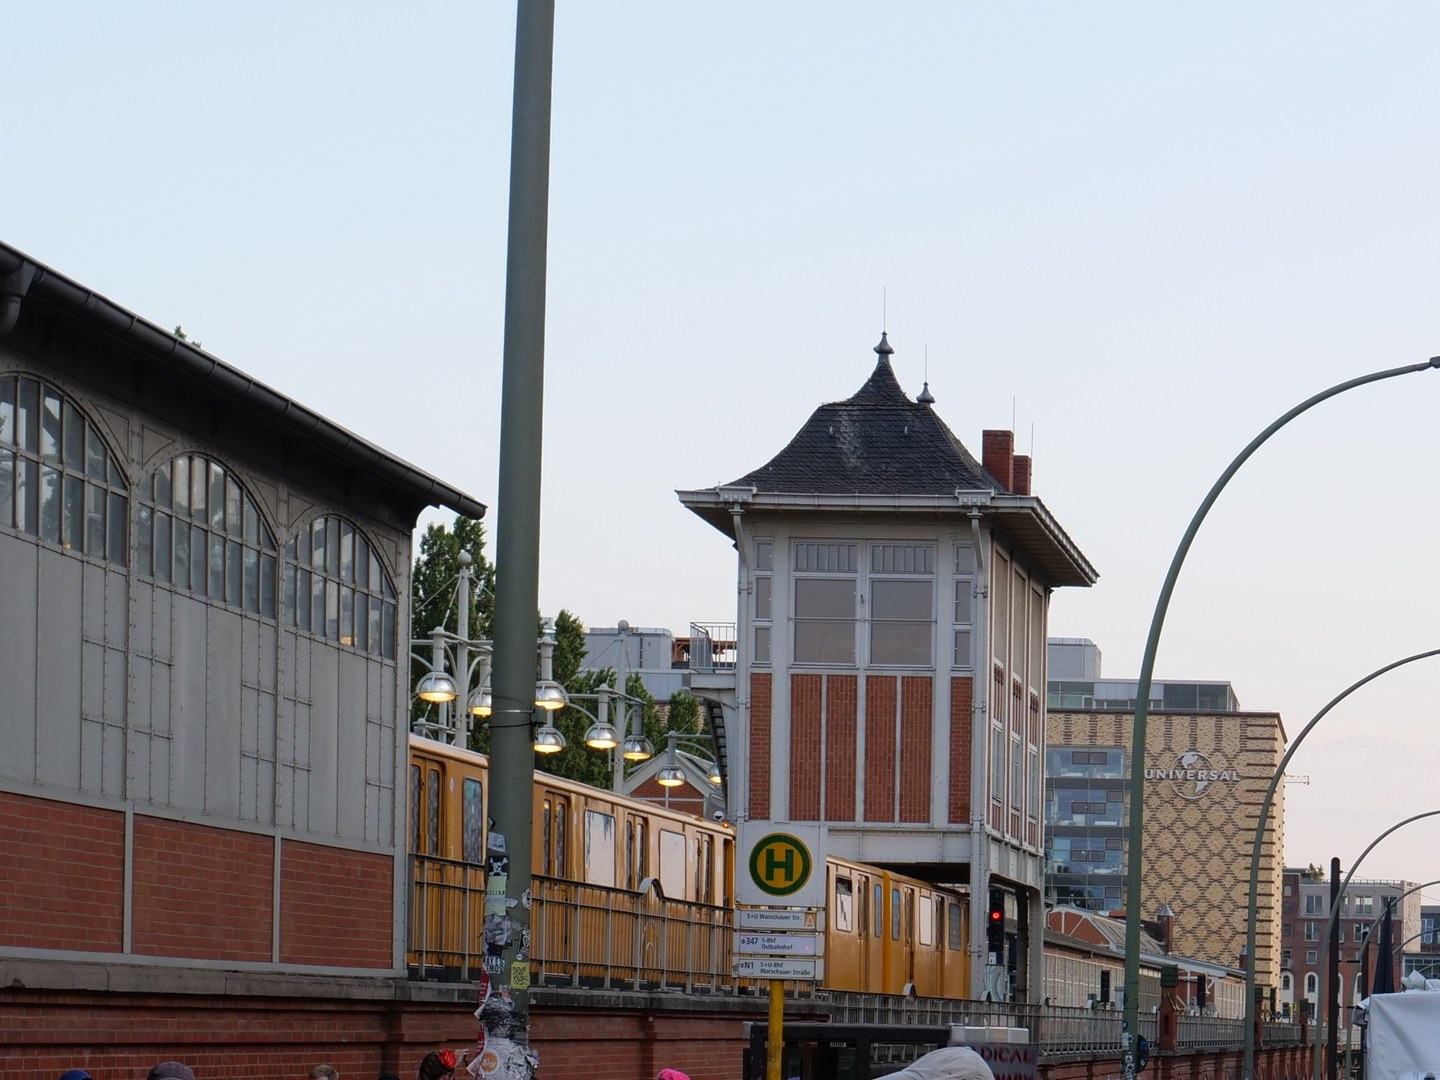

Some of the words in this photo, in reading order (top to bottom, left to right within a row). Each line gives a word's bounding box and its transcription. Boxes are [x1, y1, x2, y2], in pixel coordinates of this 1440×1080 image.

[1143, 768, 1241, 781] UNIVERSAL
[765, 848, 794, 881] H
[759, 913, 791, 921] Warschauer
[745, 937, 759, 945] 347
[761, 943, 793, 951] Ostbahnhof
[980, 1046, 1036, 1064] DICAL
